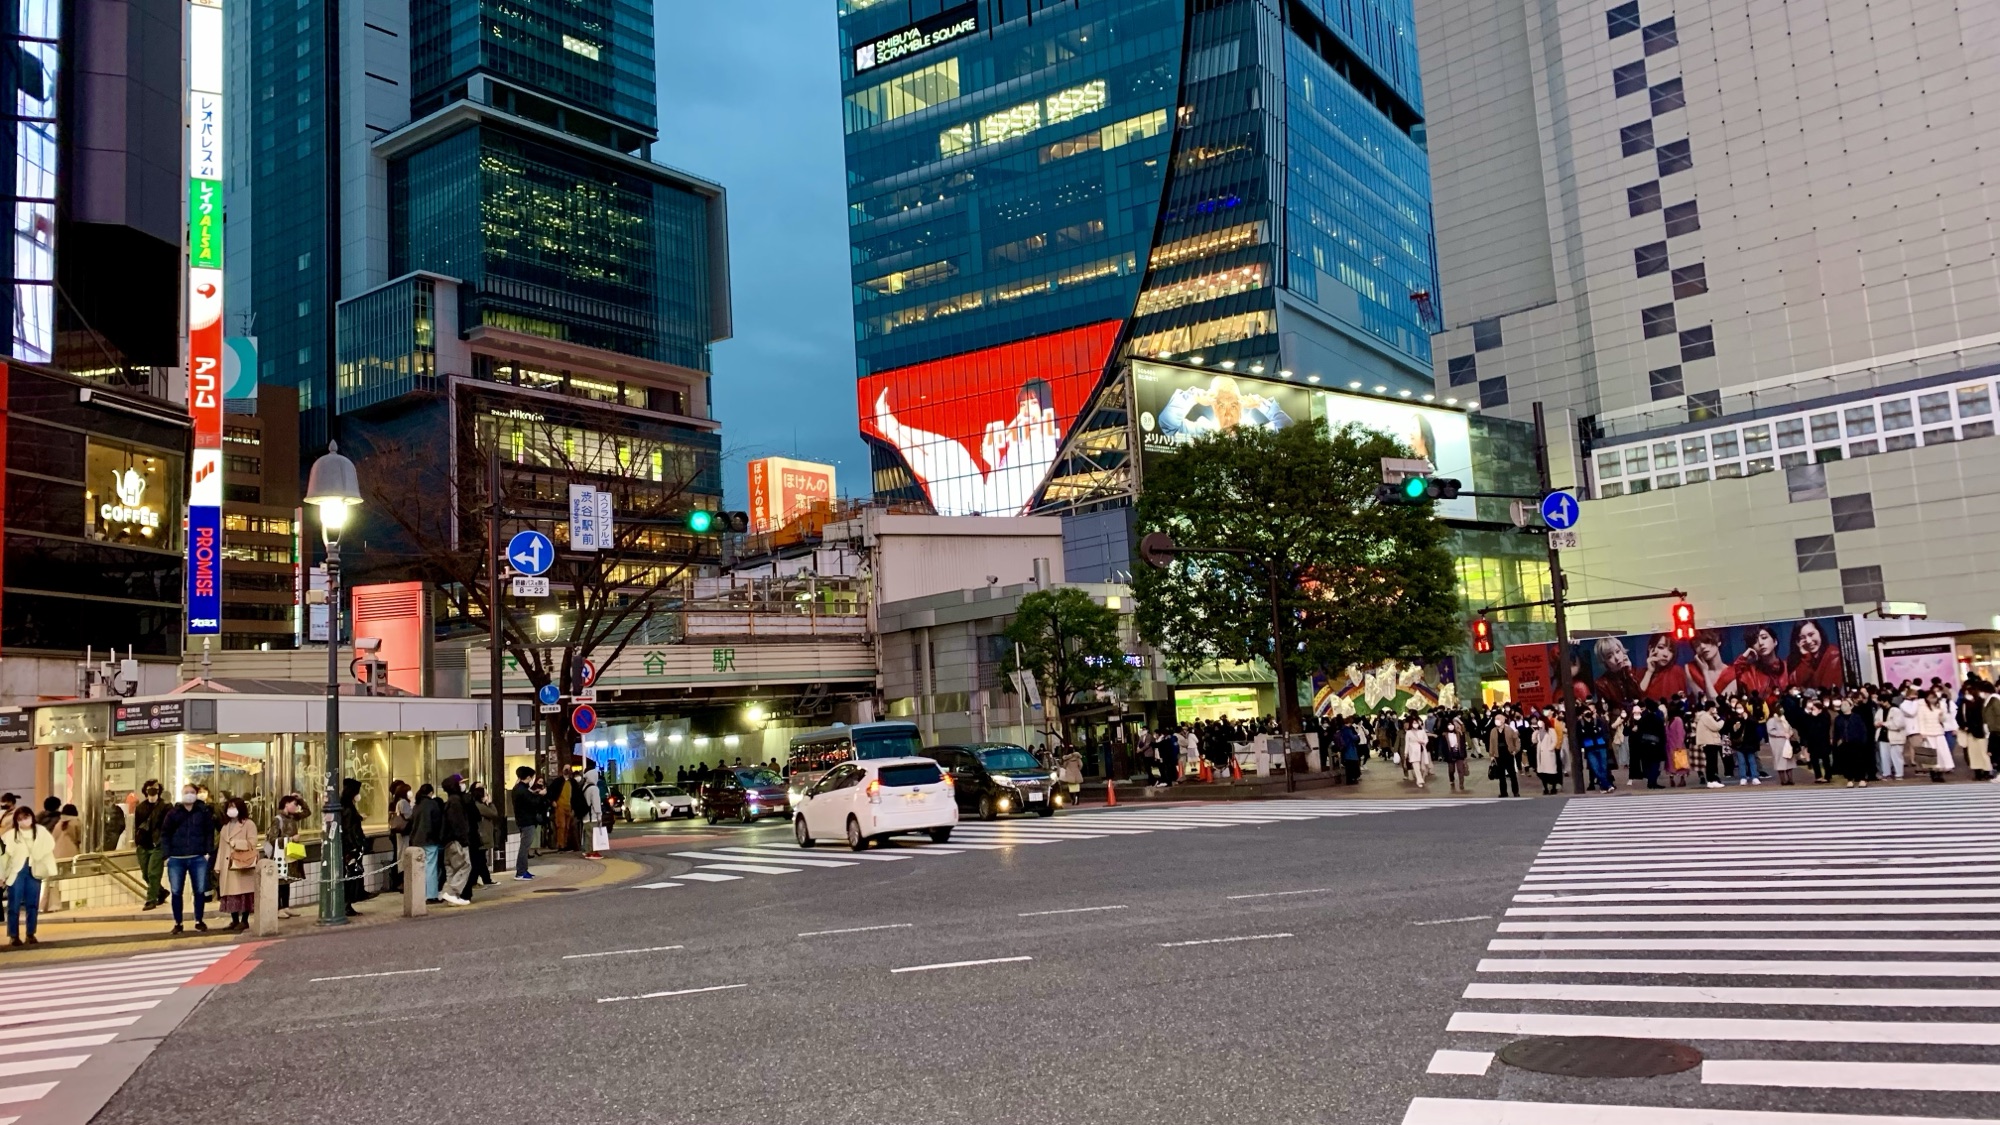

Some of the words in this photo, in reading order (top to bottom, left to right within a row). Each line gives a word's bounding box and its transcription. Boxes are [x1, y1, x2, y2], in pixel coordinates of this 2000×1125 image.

[877, 27, 921, 52] SHIBUYA
[877, 35, 931, 64] SCRAMBLE
[932, 18, 976, 44] SQUARE
[195, 356, 217, 408] アコム
[783, 473, 828, 492] ほけんの
[101, 504, 159, 528] COFFEE
[573, 498, 581, 524] Shibuya
[581, 491, 594, 546] 渋谷駅前
[600, 495, 610, 546] スクランブル式
[196, 527, 213, 597] PROMISE
